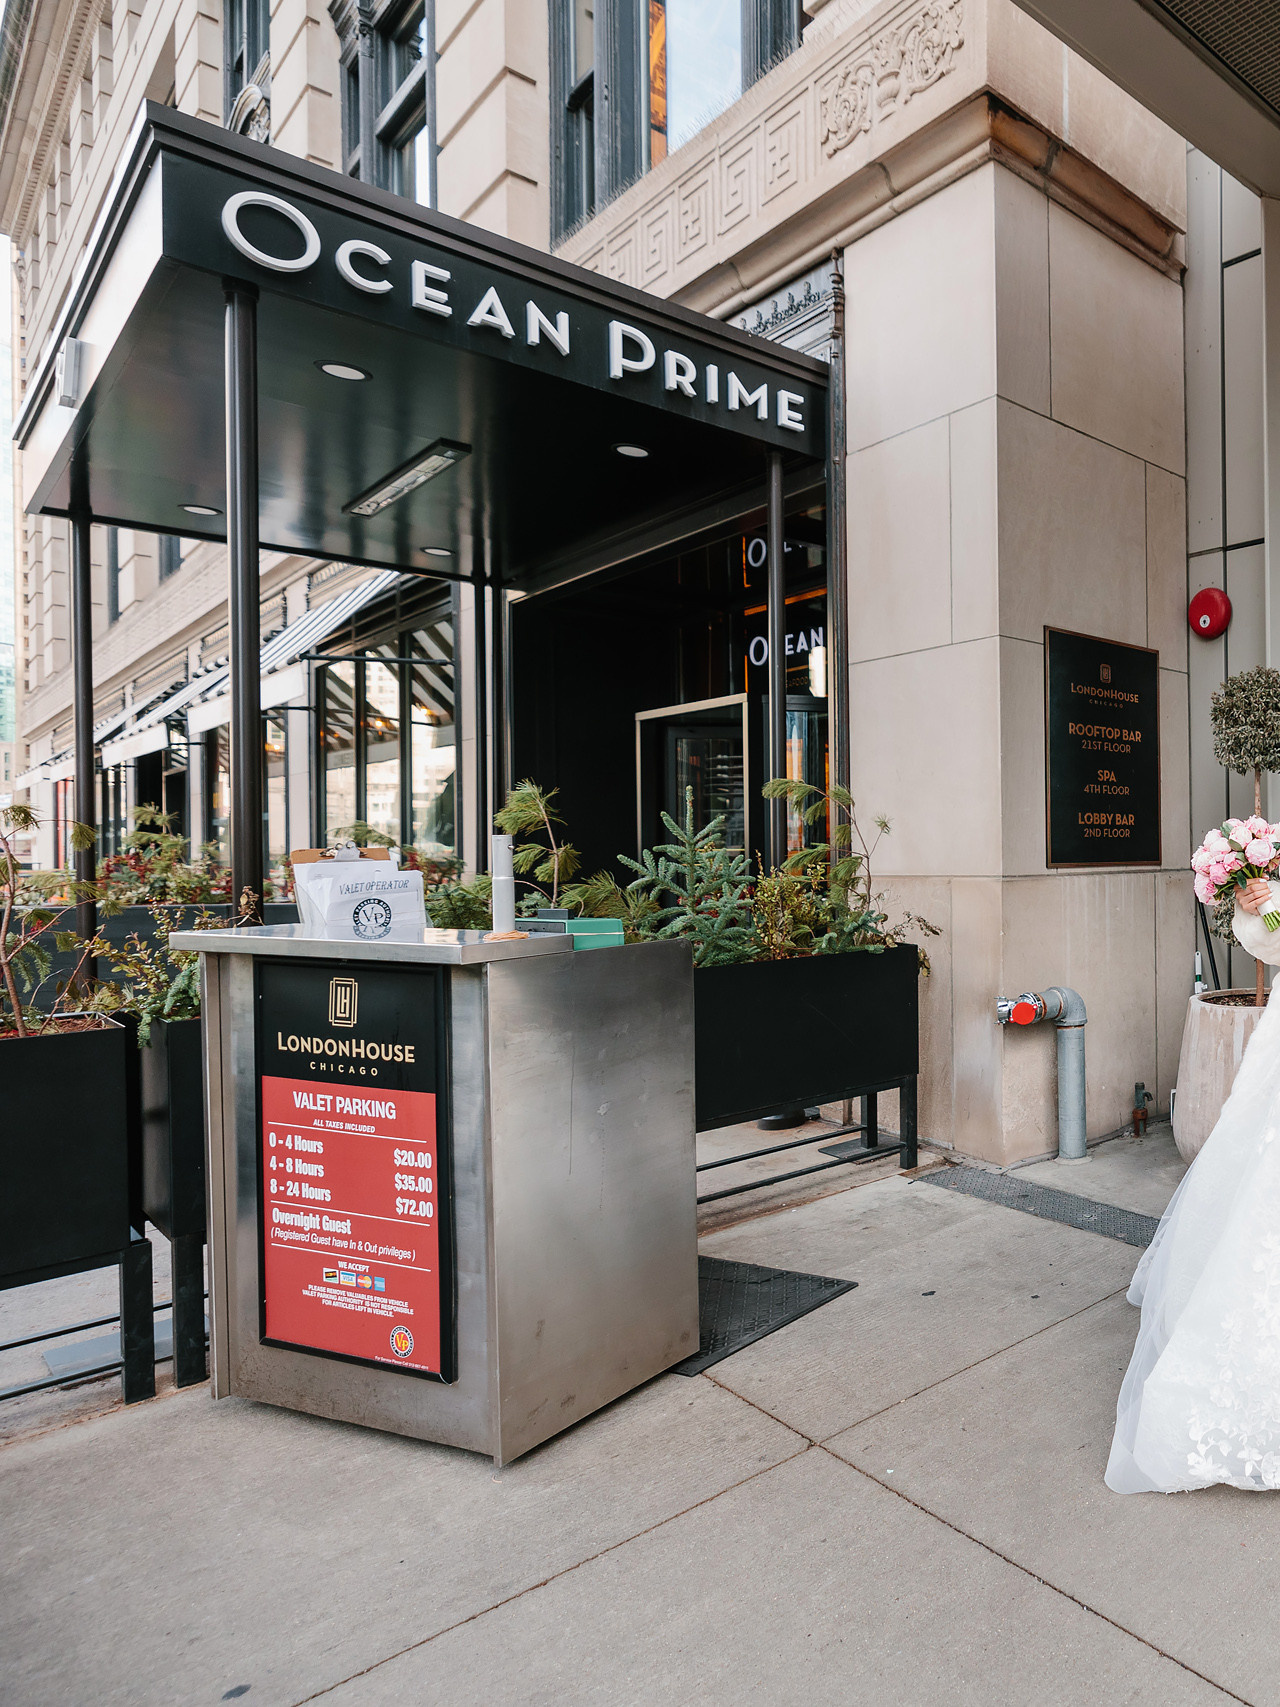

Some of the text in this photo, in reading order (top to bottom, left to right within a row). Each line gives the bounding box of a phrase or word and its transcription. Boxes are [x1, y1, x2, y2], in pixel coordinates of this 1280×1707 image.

[222, 190, 806, 434] OCEAN PRIME
[749, 625, 824, 667] OEAN
[1070, 682, 1139, 704] LONDONHOUSE
[1069, 722, 1142, 743] ROOFTOP BAR
[1081, 739, 1131, 754] 21ST FLOOR
[1097, 769, 1117, 783] SPA
[1083, 784, 1130, 796] 4TH FLOOR
[1078, 812, 1135, 826] LOBBY BAR
[1083, 828, 1130, 839] 2ND FLOOR
[339, 879, 410, 895] VALET OPERATOR
[277, 1031, 416, 1063] LONDONHOUSE
[309, 1061, 379, 1077] CHICAGO
[293, 1091, 397, 1120] VALET PARKING
[313, 1118, 376, 1134] ALL TAXES INCLUDED
[269, 1132, 277, 1148] 0
[285, 1134, 293, 1150] 4
[294, 1135, 324, 1154] Hours
[393, 1148, 432, 1169] $20.00
[270, 1156, 277, 1171] 4
[286, 1158, 293, 1173] 8
[294, 1158, 324, 1177] Hours
[394, 1173, 433, 1194] $35.00
[270, 1178, 278, 1194] 8
[286, 1181, 300, 1197] 24
[301, 1183, 331, 1202] Hours
[395, 1196, 434, 1218] $72.00
[272, 1207, 352, 1235] Overnight Guest
[310, 1233, 331, 1246] Guest
[332, 1239, 348, 1248] have
[349, 1239, 356, 1250] In
[357, 1241, 363, 1251] &
[364, 1241, 377, 1253] Out
[338, 1260, 370, 1273] WE ACCEPT
[308, 1284, 326, 1292] PLEASE
[396, 1334, 409, 1350] VP
